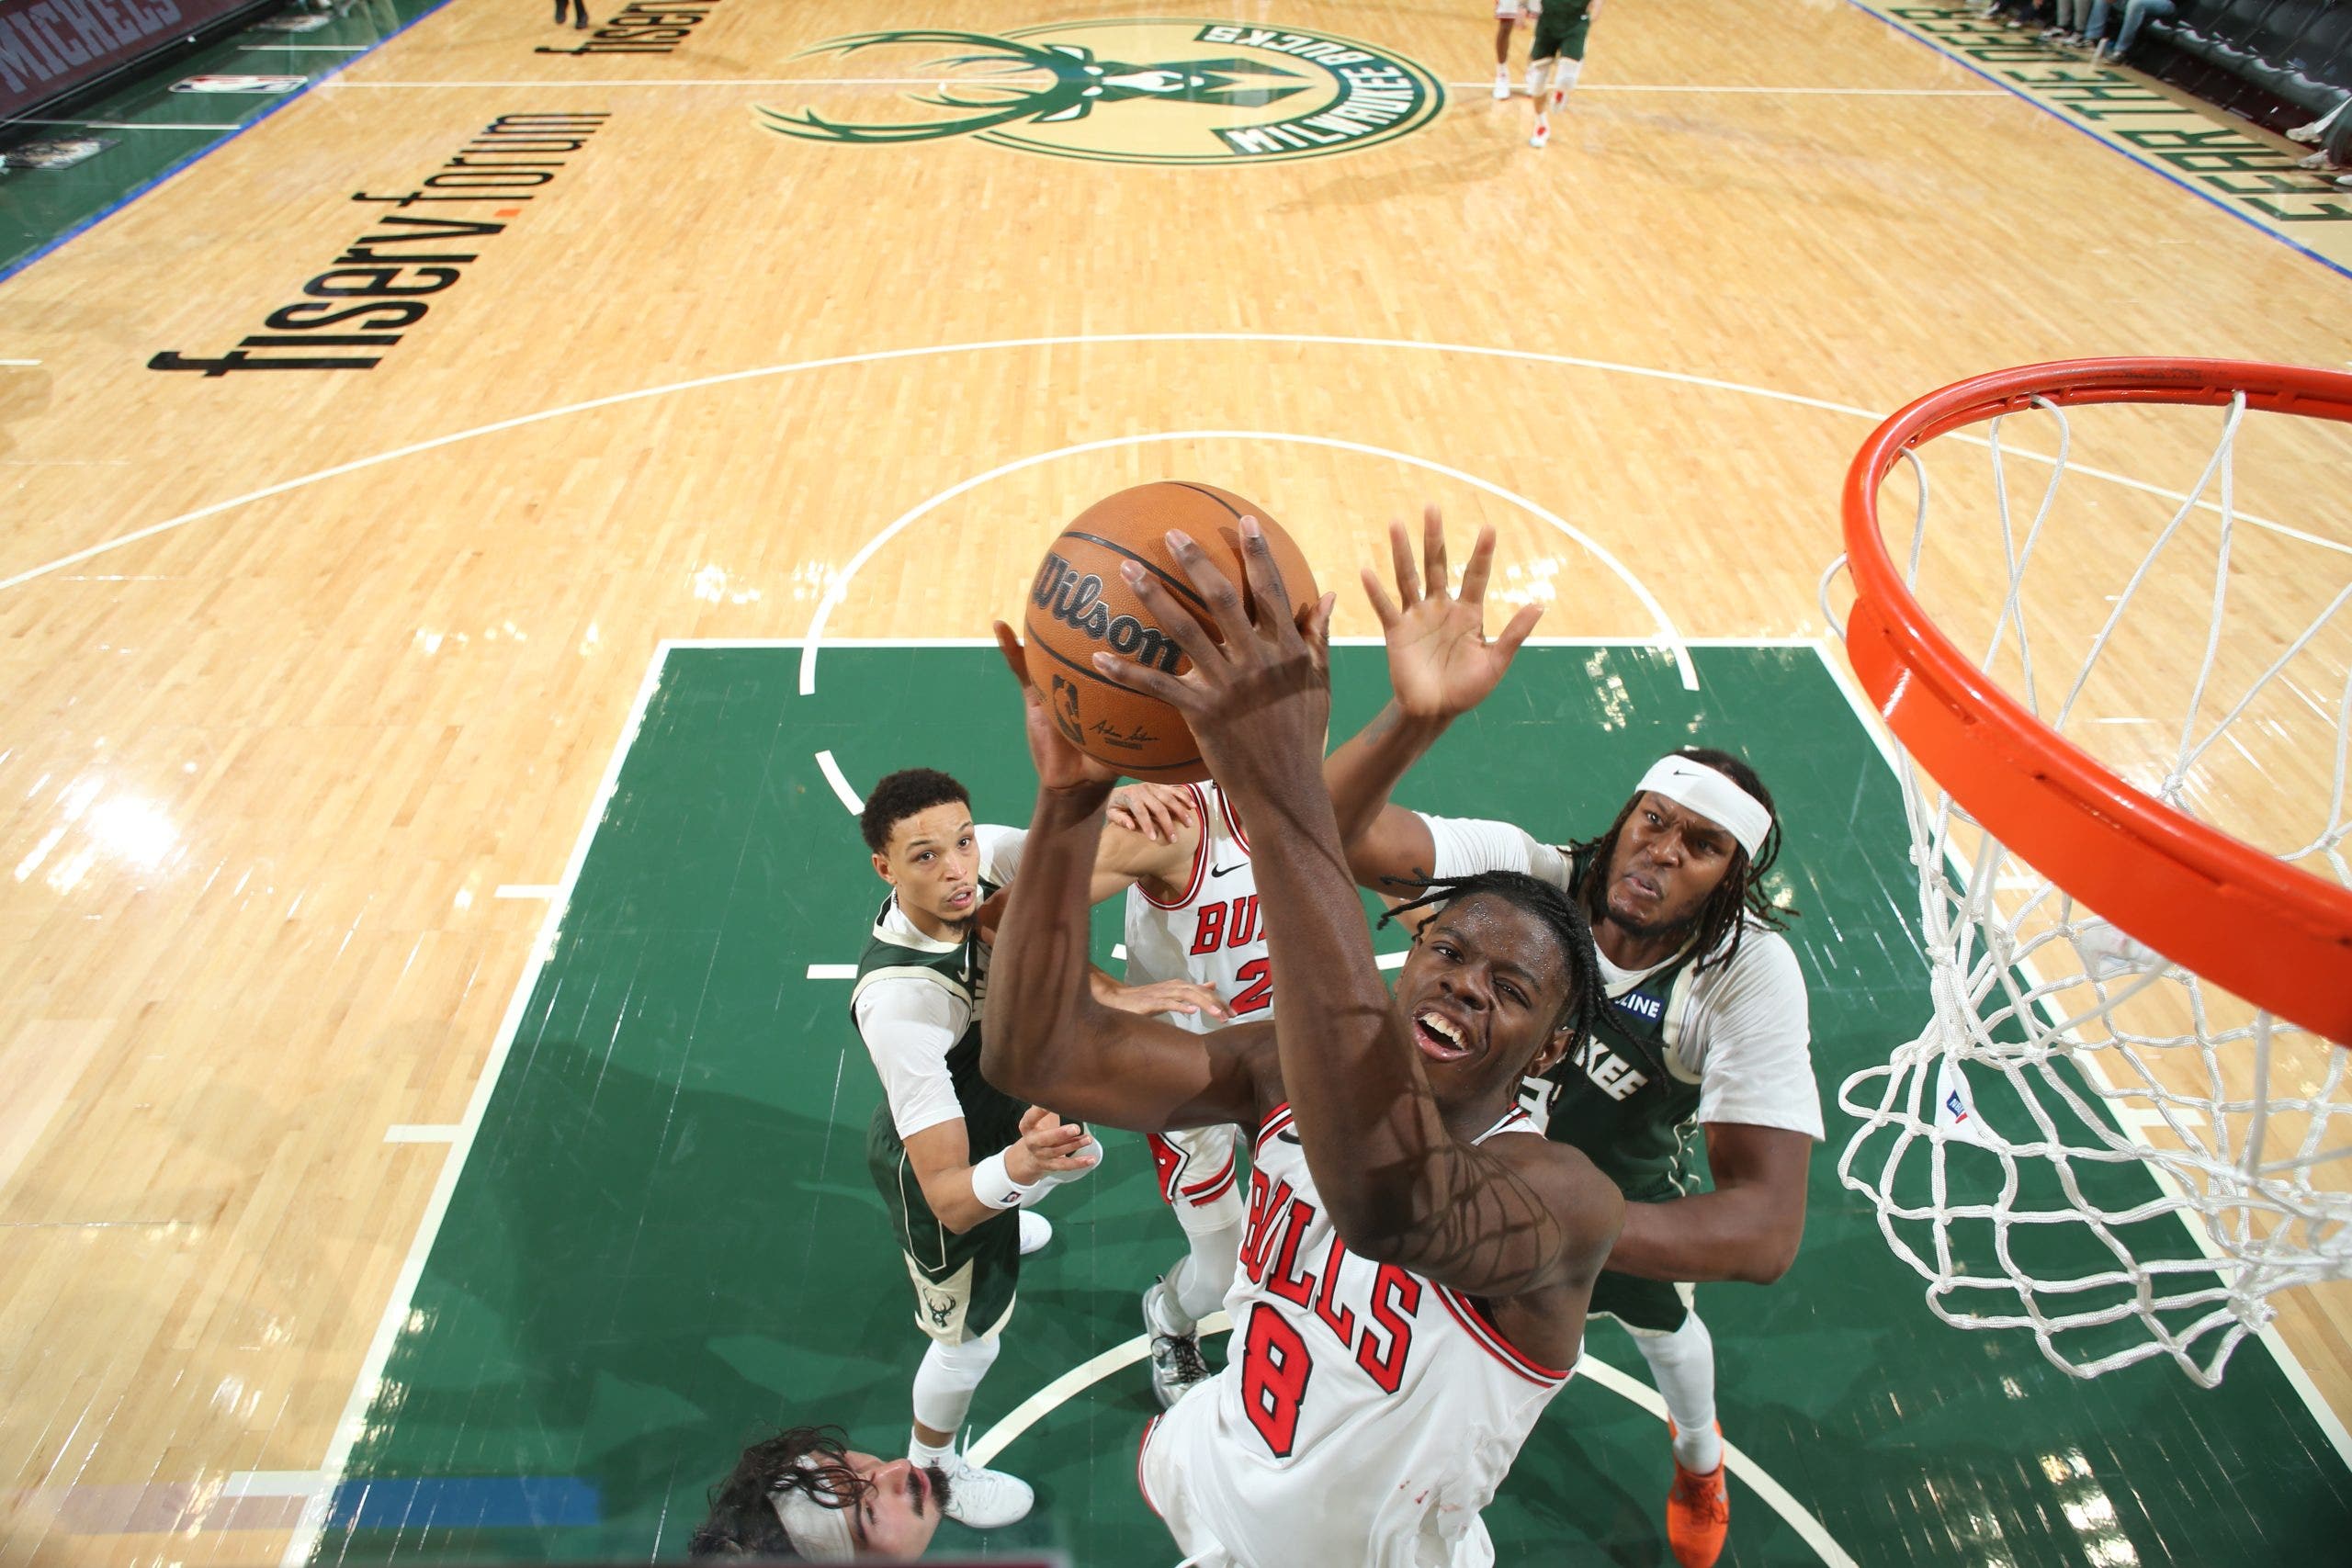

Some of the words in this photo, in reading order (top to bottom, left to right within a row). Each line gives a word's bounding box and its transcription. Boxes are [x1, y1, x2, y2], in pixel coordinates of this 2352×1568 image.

[534, 0, 721, 55] fiser
[1203, 26, 1375, 66] BUCKS
[1225, 65, 1415, 154] MILWAUKEE
[2000, 70, 2197, 120] THE
[1032, 551, 1183, 675] Wilson
[1190, 894, 1267, 955] BU
[1572, 1034, 1649, 1101] KEE
[1238, 1168, 1423, 1395] BULLS
[1240, 1300, 1314, 1459] 8
